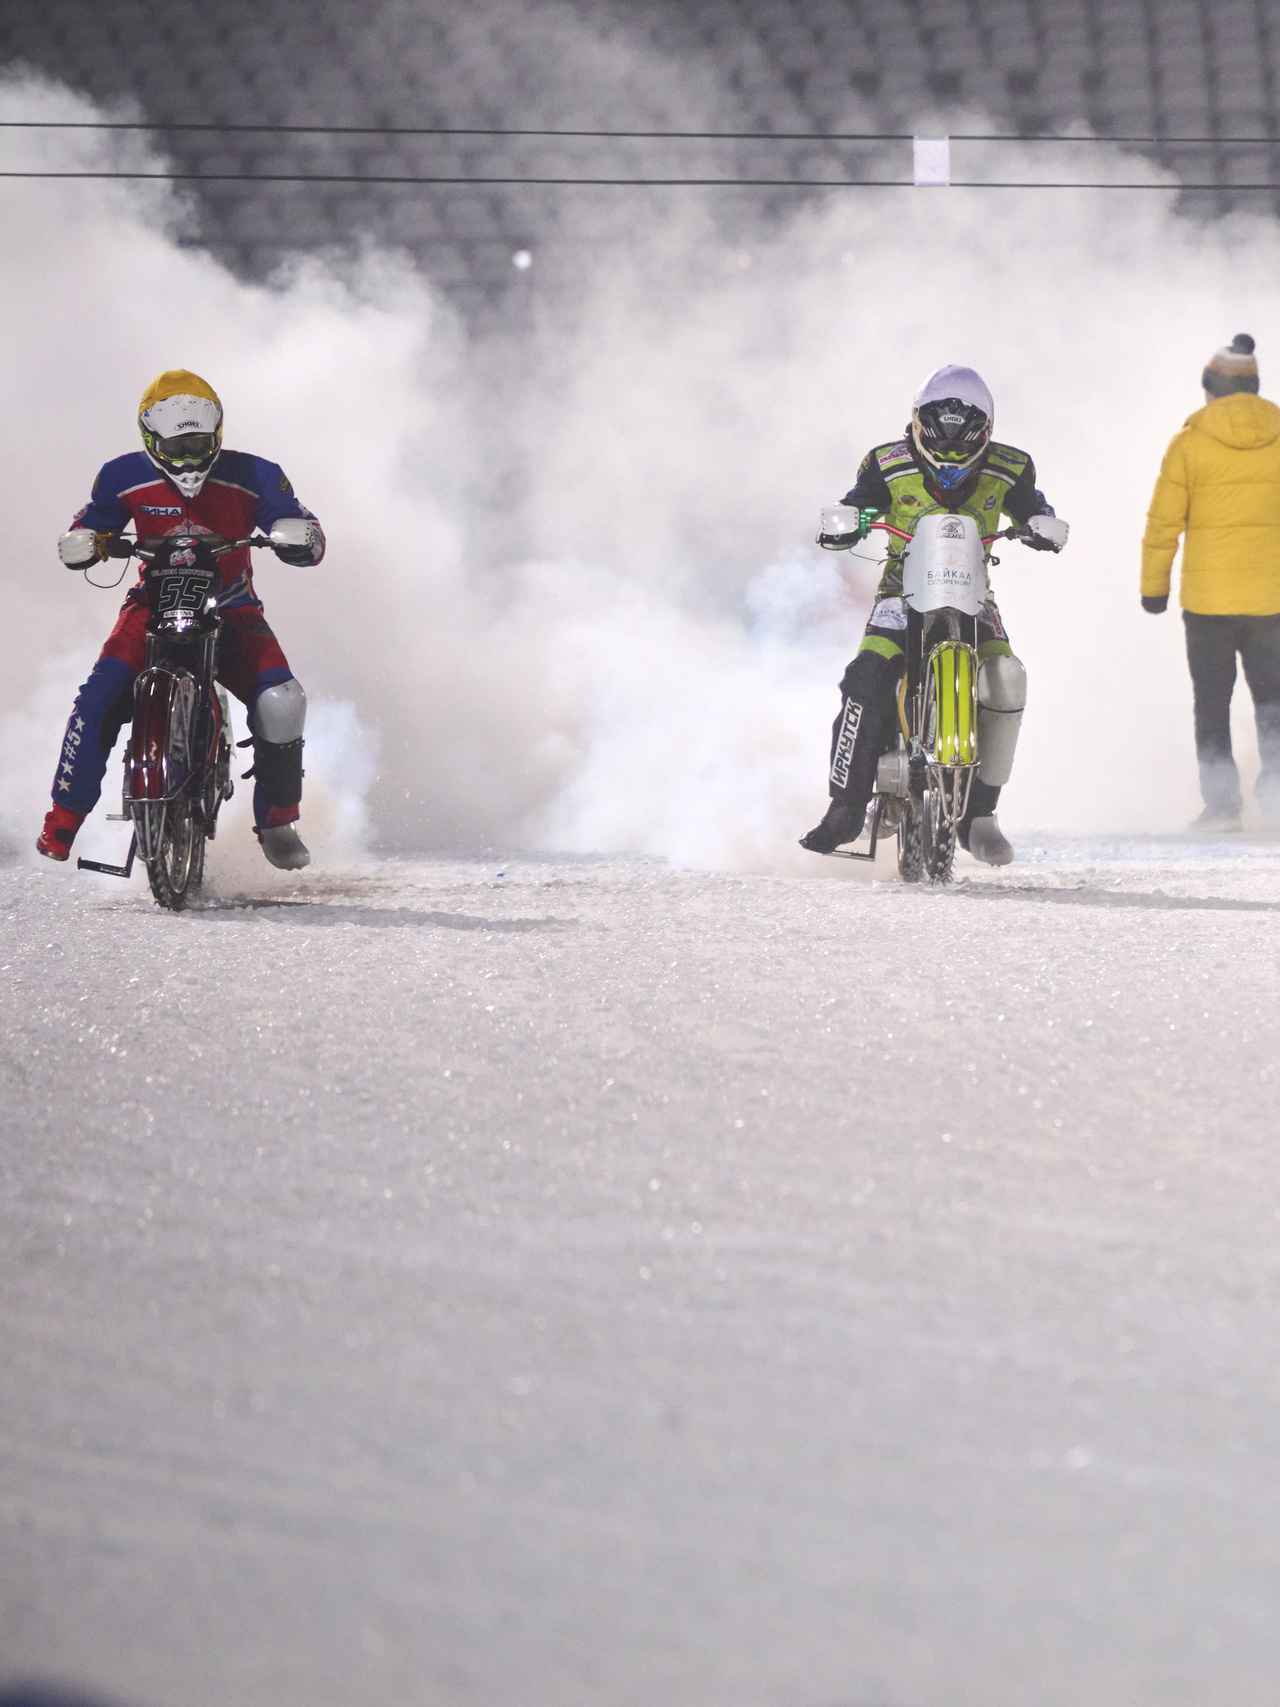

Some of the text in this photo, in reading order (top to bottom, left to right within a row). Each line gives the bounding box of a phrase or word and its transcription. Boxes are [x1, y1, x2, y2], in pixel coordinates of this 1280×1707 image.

[178, 421, 199, 429] SHOEI
[943, 415, 962, 423] SHOEI
[927, 568, 972, 580] БАЙКАЛ
[159, 577, 210, 611] 55
[63, 728, 82, 760] #5
[831, 697, 862, 788] ИРКУТСК
